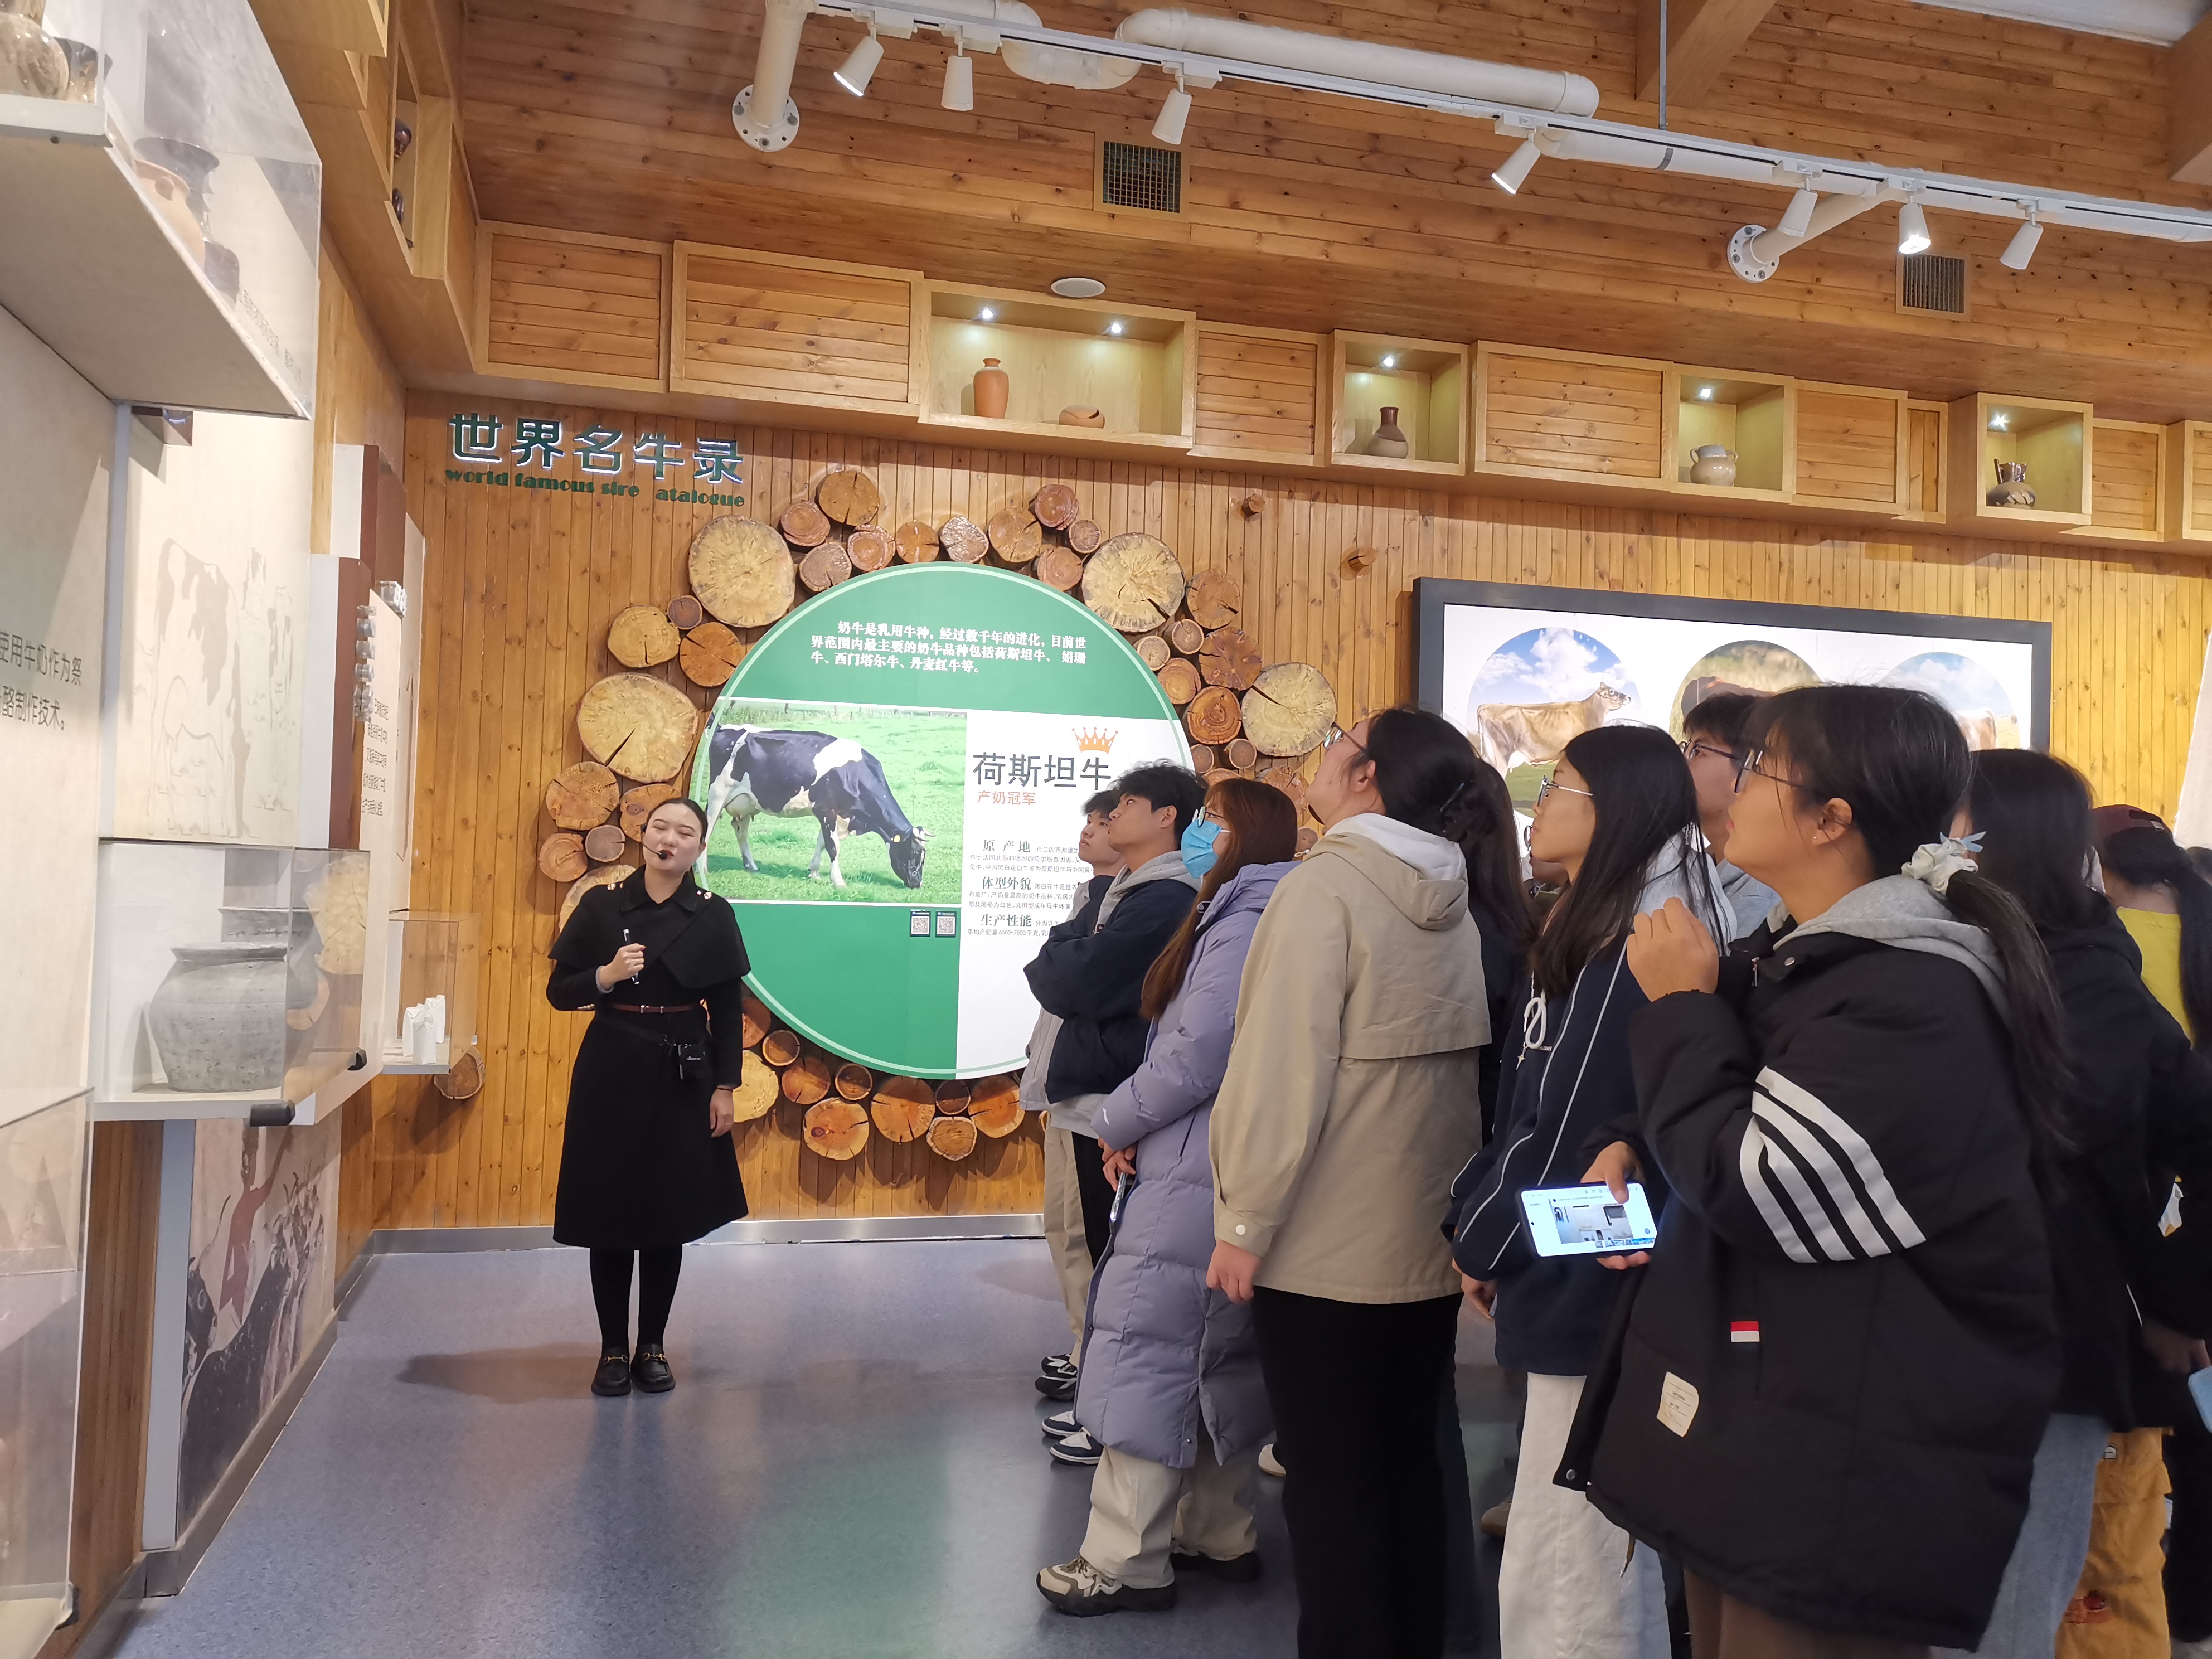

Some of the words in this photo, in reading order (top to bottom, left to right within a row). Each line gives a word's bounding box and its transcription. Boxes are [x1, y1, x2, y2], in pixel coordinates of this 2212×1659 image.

[449, 413, 743, 484] 世界名牛录
[445, 469, 509, 486] world
[515, 473, 595, 493] famous
[810, 650, 979, 673] 牛、西门塔尔牛、丹麦红牛等。
[973, 752, 1111, 790] 荷斯坦牛
[977, 790, 1036, 805] 产奶冠军
[982, 876, 1031, 890] 体型外貌
[981, 914, 1031, 927] 生产性能
